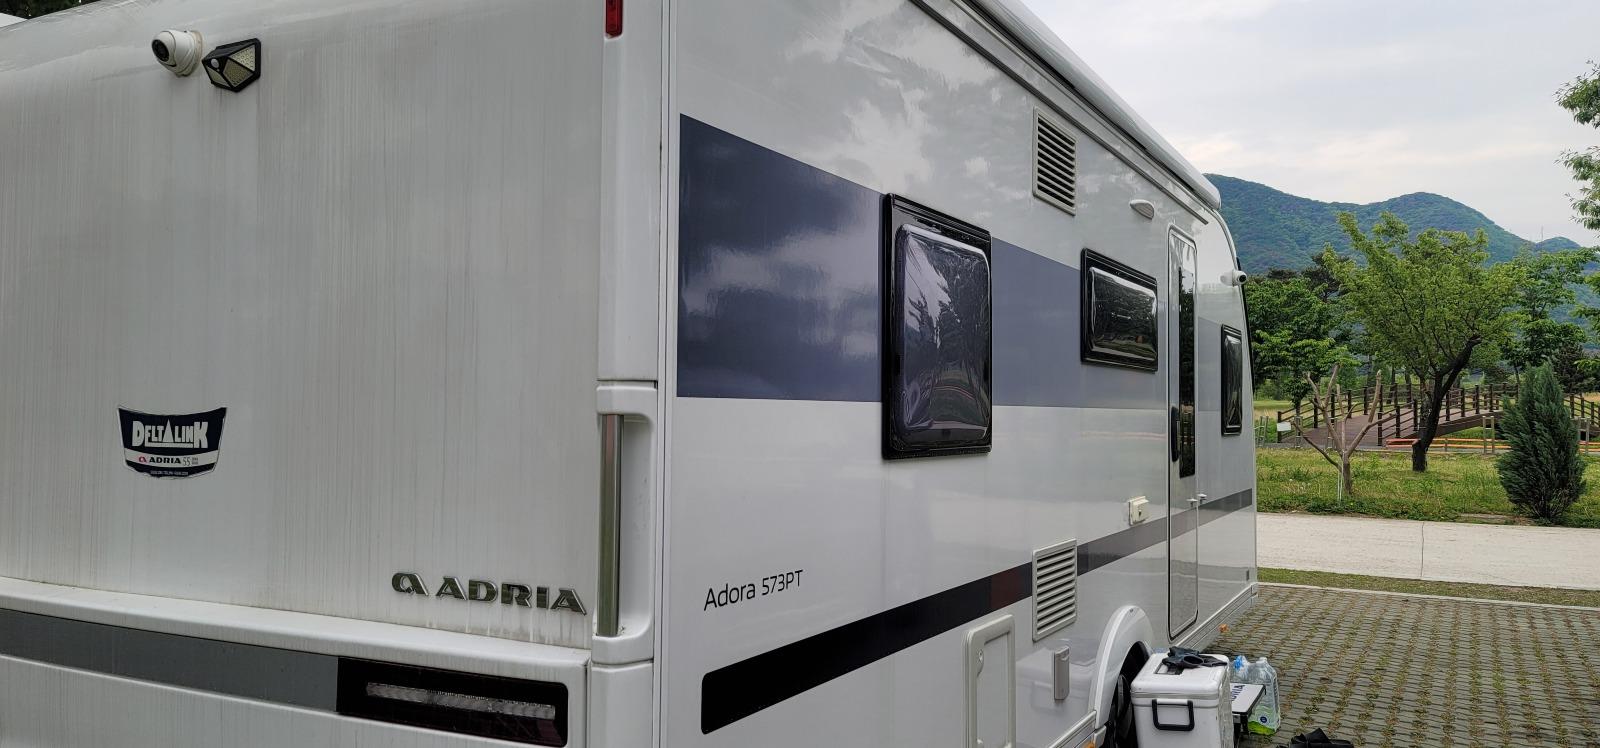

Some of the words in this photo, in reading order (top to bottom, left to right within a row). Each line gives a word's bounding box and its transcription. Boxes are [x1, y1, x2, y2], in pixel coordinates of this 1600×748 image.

[131, 418, 209, 449] DELTALINK
[149, 456, 182, 464] ADRIA
[435, 576, 587, 616] ADRIA
[703, 582, 756, 612] Adora
[761, 568, 804, 596] 573PT
